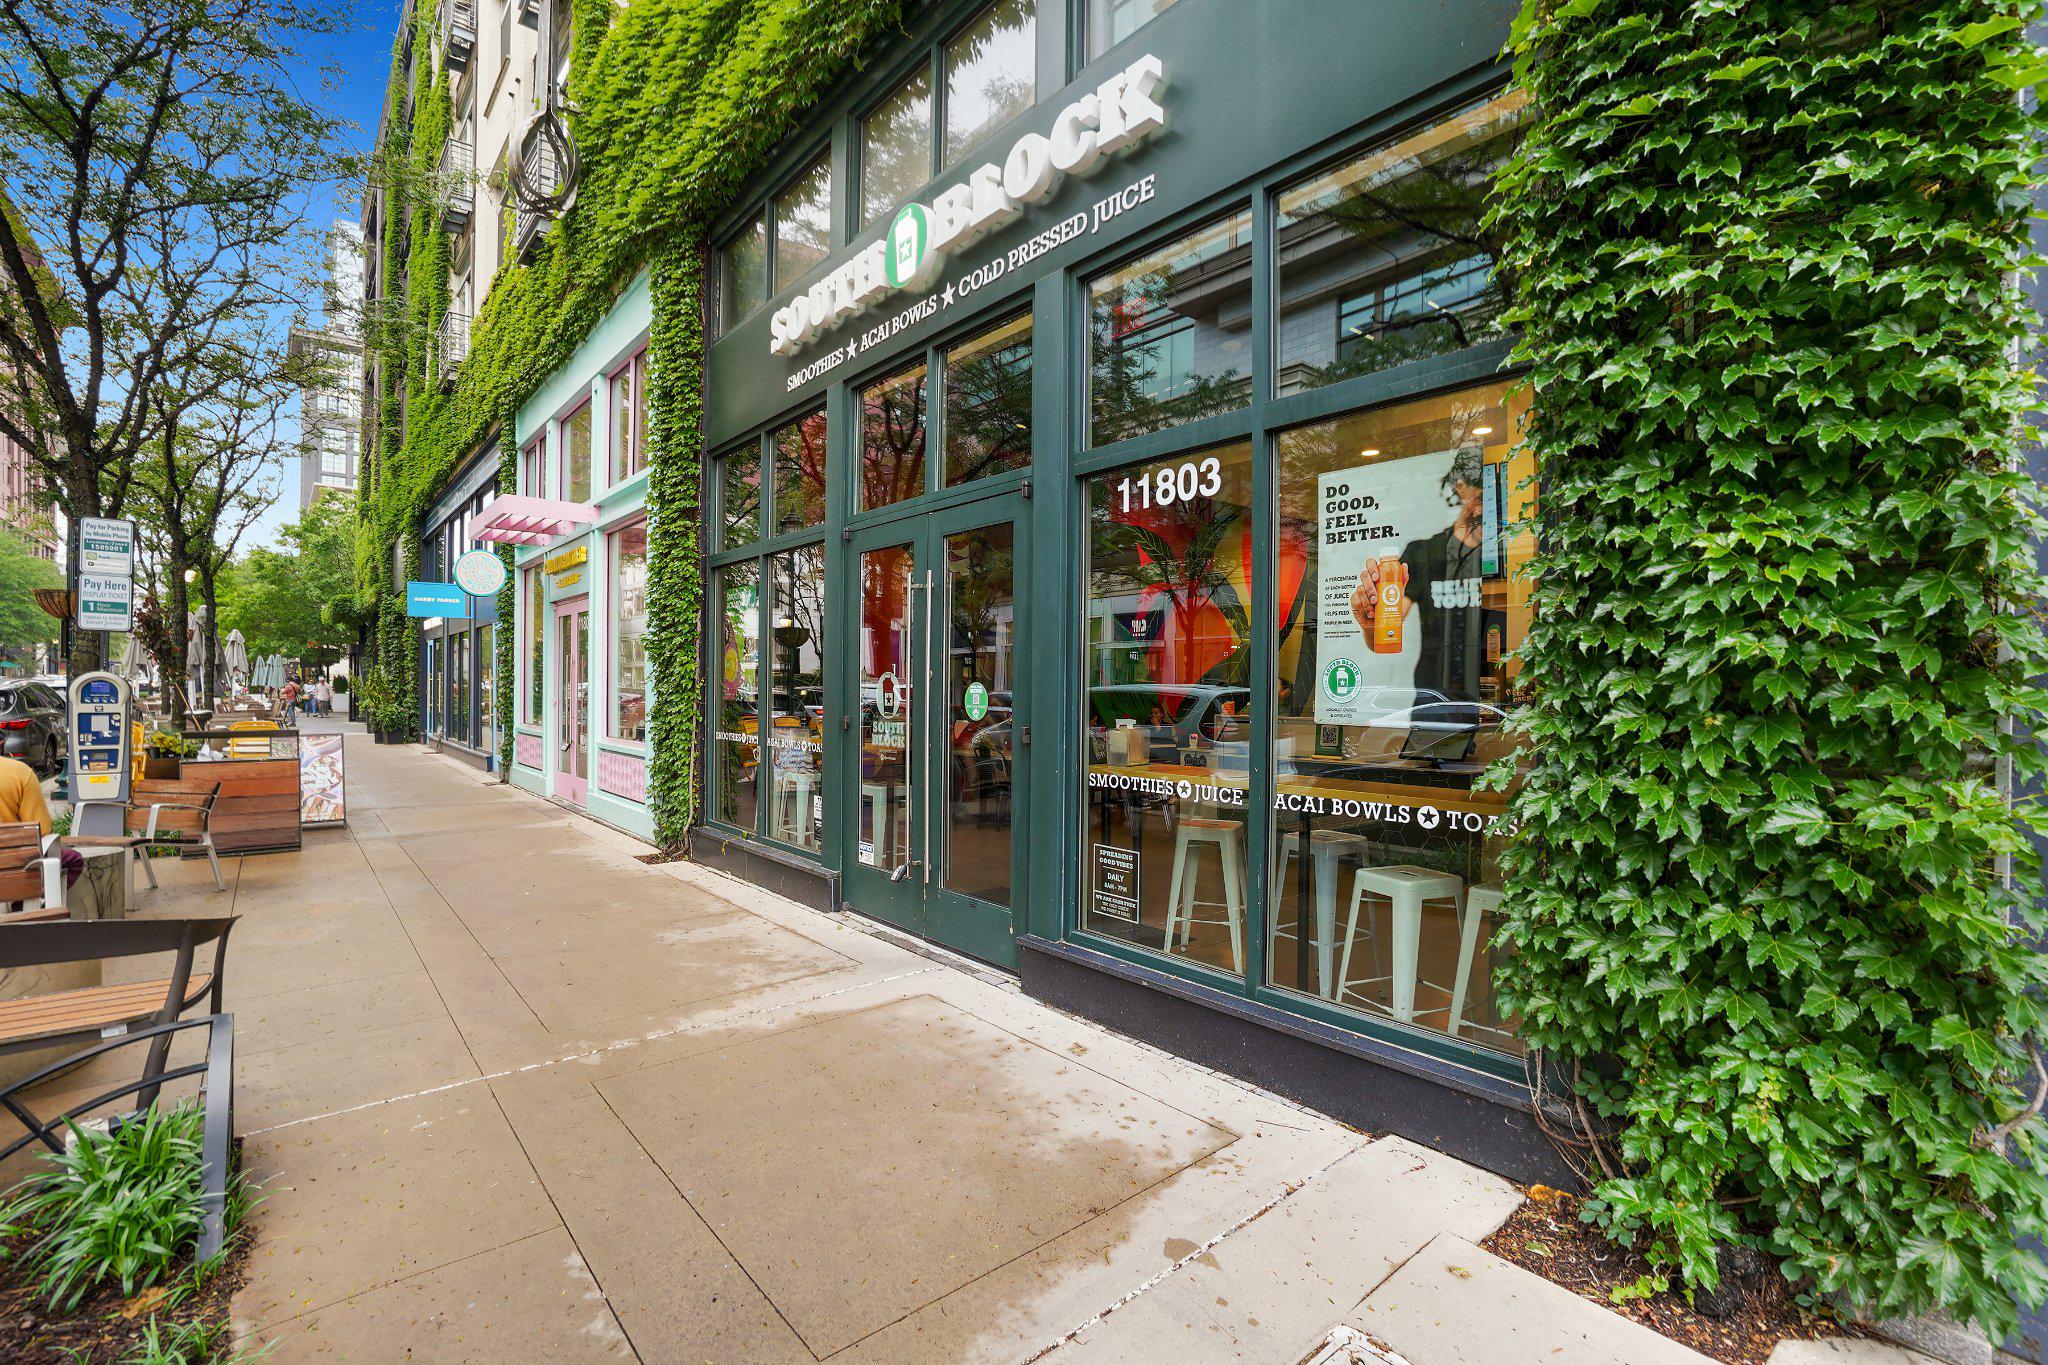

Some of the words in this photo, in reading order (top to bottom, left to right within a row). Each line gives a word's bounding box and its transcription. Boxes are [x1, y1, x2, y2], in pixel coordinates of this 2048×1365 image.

[770, 239, 891, 355] SOUTH
[932, 53, 1164, 253] BLOCK
[787, 348, 844, 392] SMOOTHIES
[859, 321, 891, 353] ACAI
[892, 295, 937, 335] BOWLS
[958, 257, 1005, 297] COLD
[1007, 212, 1088, 273] PRESSED
[1091, 174, 1156, 234] JUICE
[1117, 457, 1222, 513] 11803
[1325, 483, 1350, 498] DO
[1325, 496, 1379, 513] GOOD,
[1325, 513, 1367, 529] FEEL
[1325, 525, 1400, 545] BETTER.
[84, 579, 102, 591] Pay
[104, 580, 127, 591] Here
[88, 602, 94, 612] 1
[1325, 660, 1341, 676] SOUTH
[1342, 660, 1360, 676] BLOCK
[872, 721, 905, 734] SOUTH
[715, 731, 742, 742] SMOOTHIES
[871, 733, 906, 749] BLOCK
[781, 739, 801, 750] BOWLS
[1088, 772, 1174, 796] SMOOTHIES
[1193, 783, 1243, 806] JUICE
[1273, 793, 1325, 814] ACAI
[1331, 798, 1410, 824] BOWLS
[1099, 849, 1133, 861] SPREADING
[1099, 857, 1116, 866] GOOD
[1115, 860, 1134, 870] VIBES
[1107, 872, 1125, 883] DAILY
